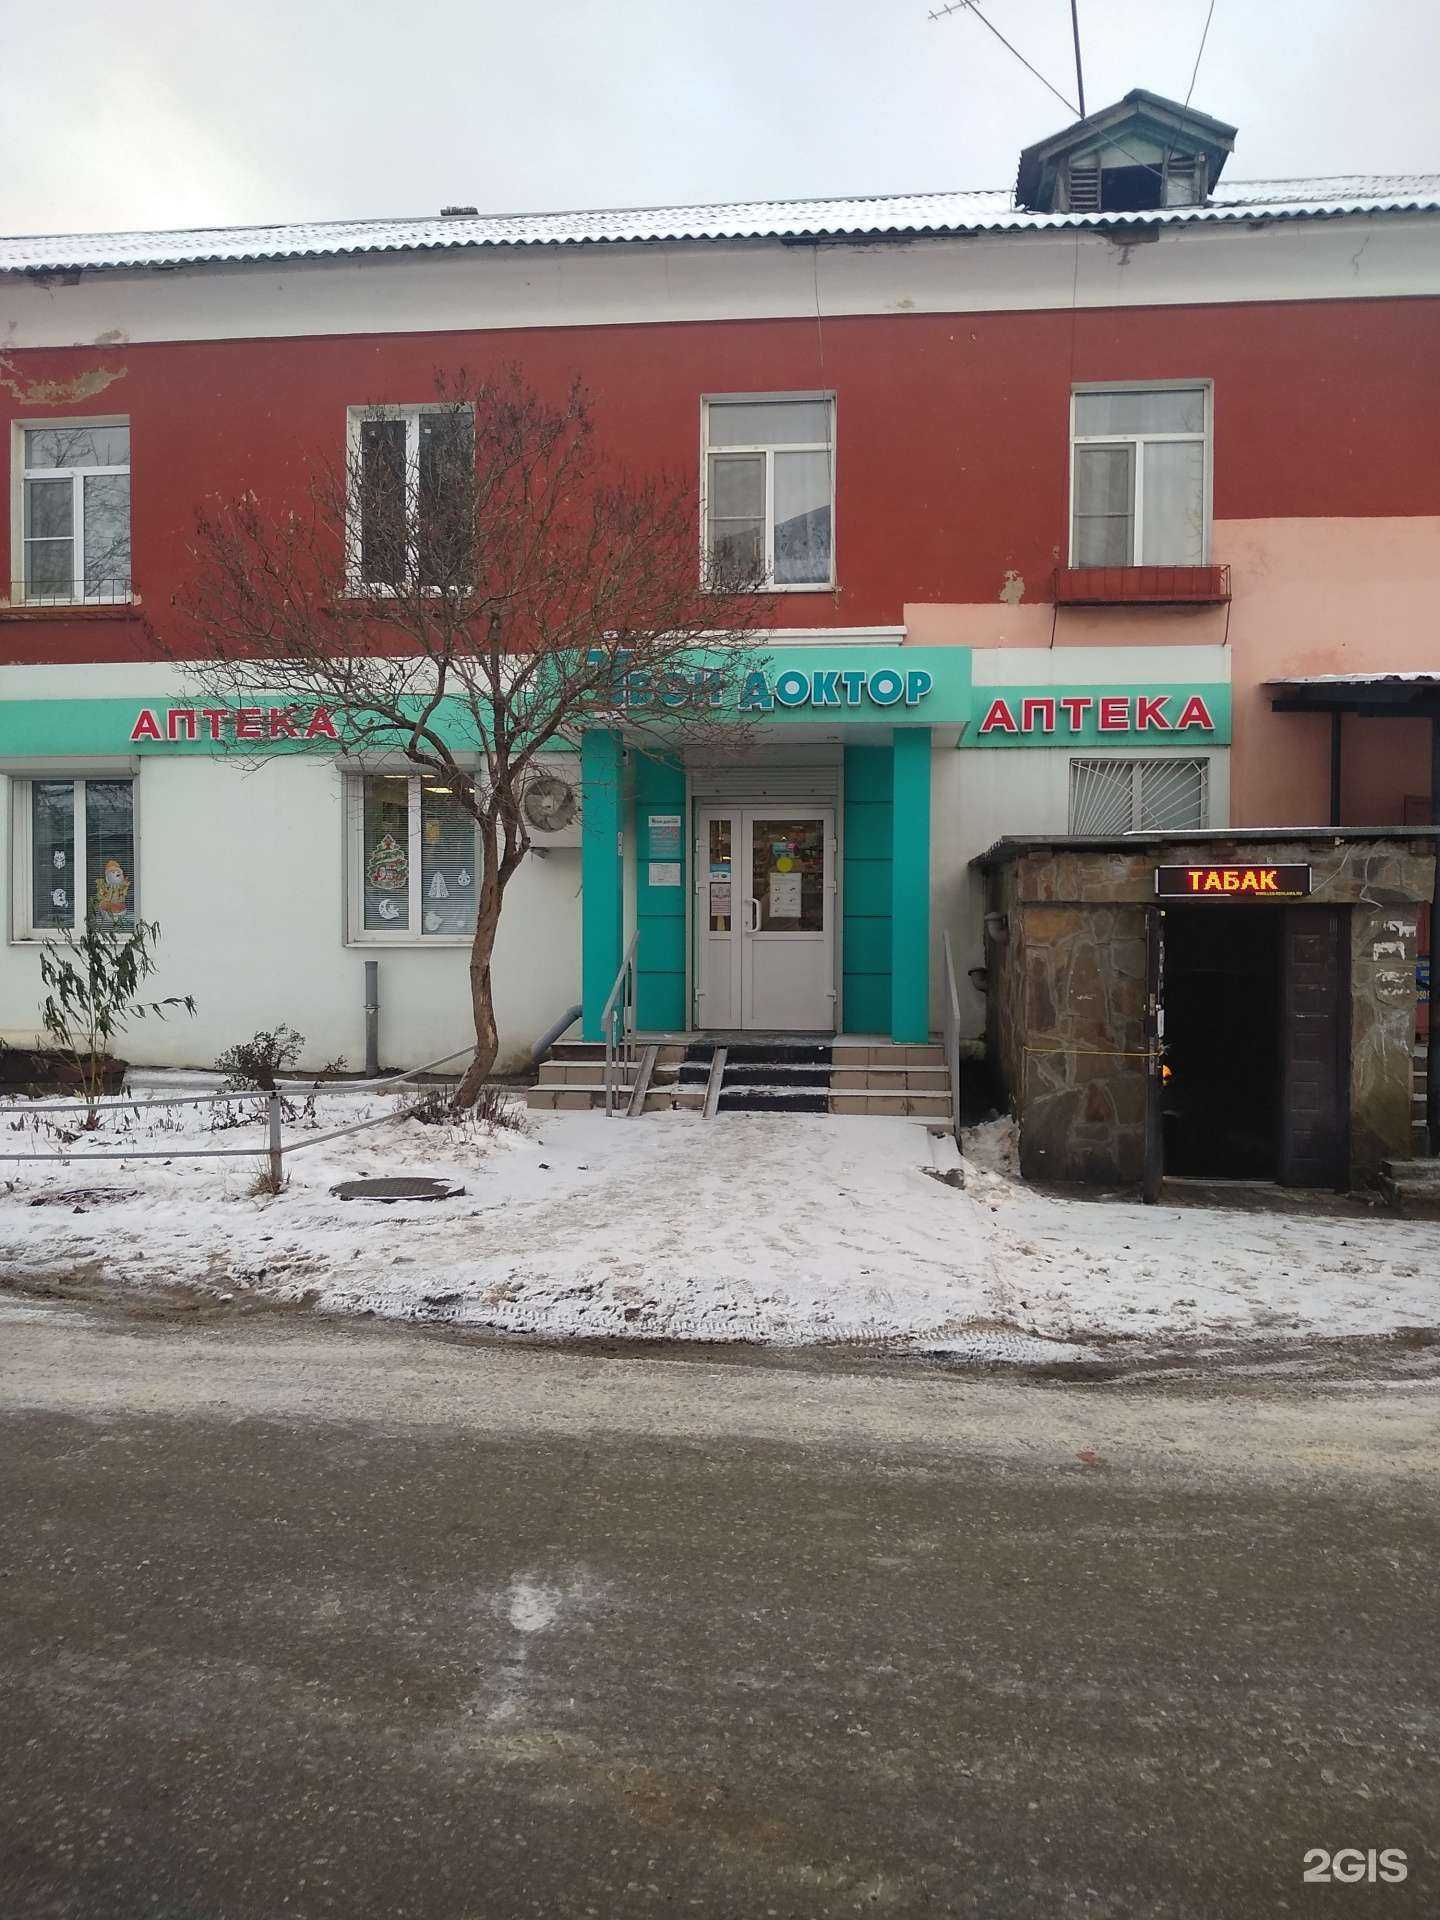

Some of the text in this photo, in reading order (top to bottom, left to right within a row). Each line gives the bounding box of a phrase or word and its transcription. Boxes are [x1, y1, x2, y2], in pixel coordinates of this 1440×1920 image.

[738, 668, 933, 711] ДОКТОР
[130, 707, 338, 741] АПТЕКА
[980, 695, 1215, 733] АПТЕКА
[1188, 870, 1279, 891] ТАБАК
